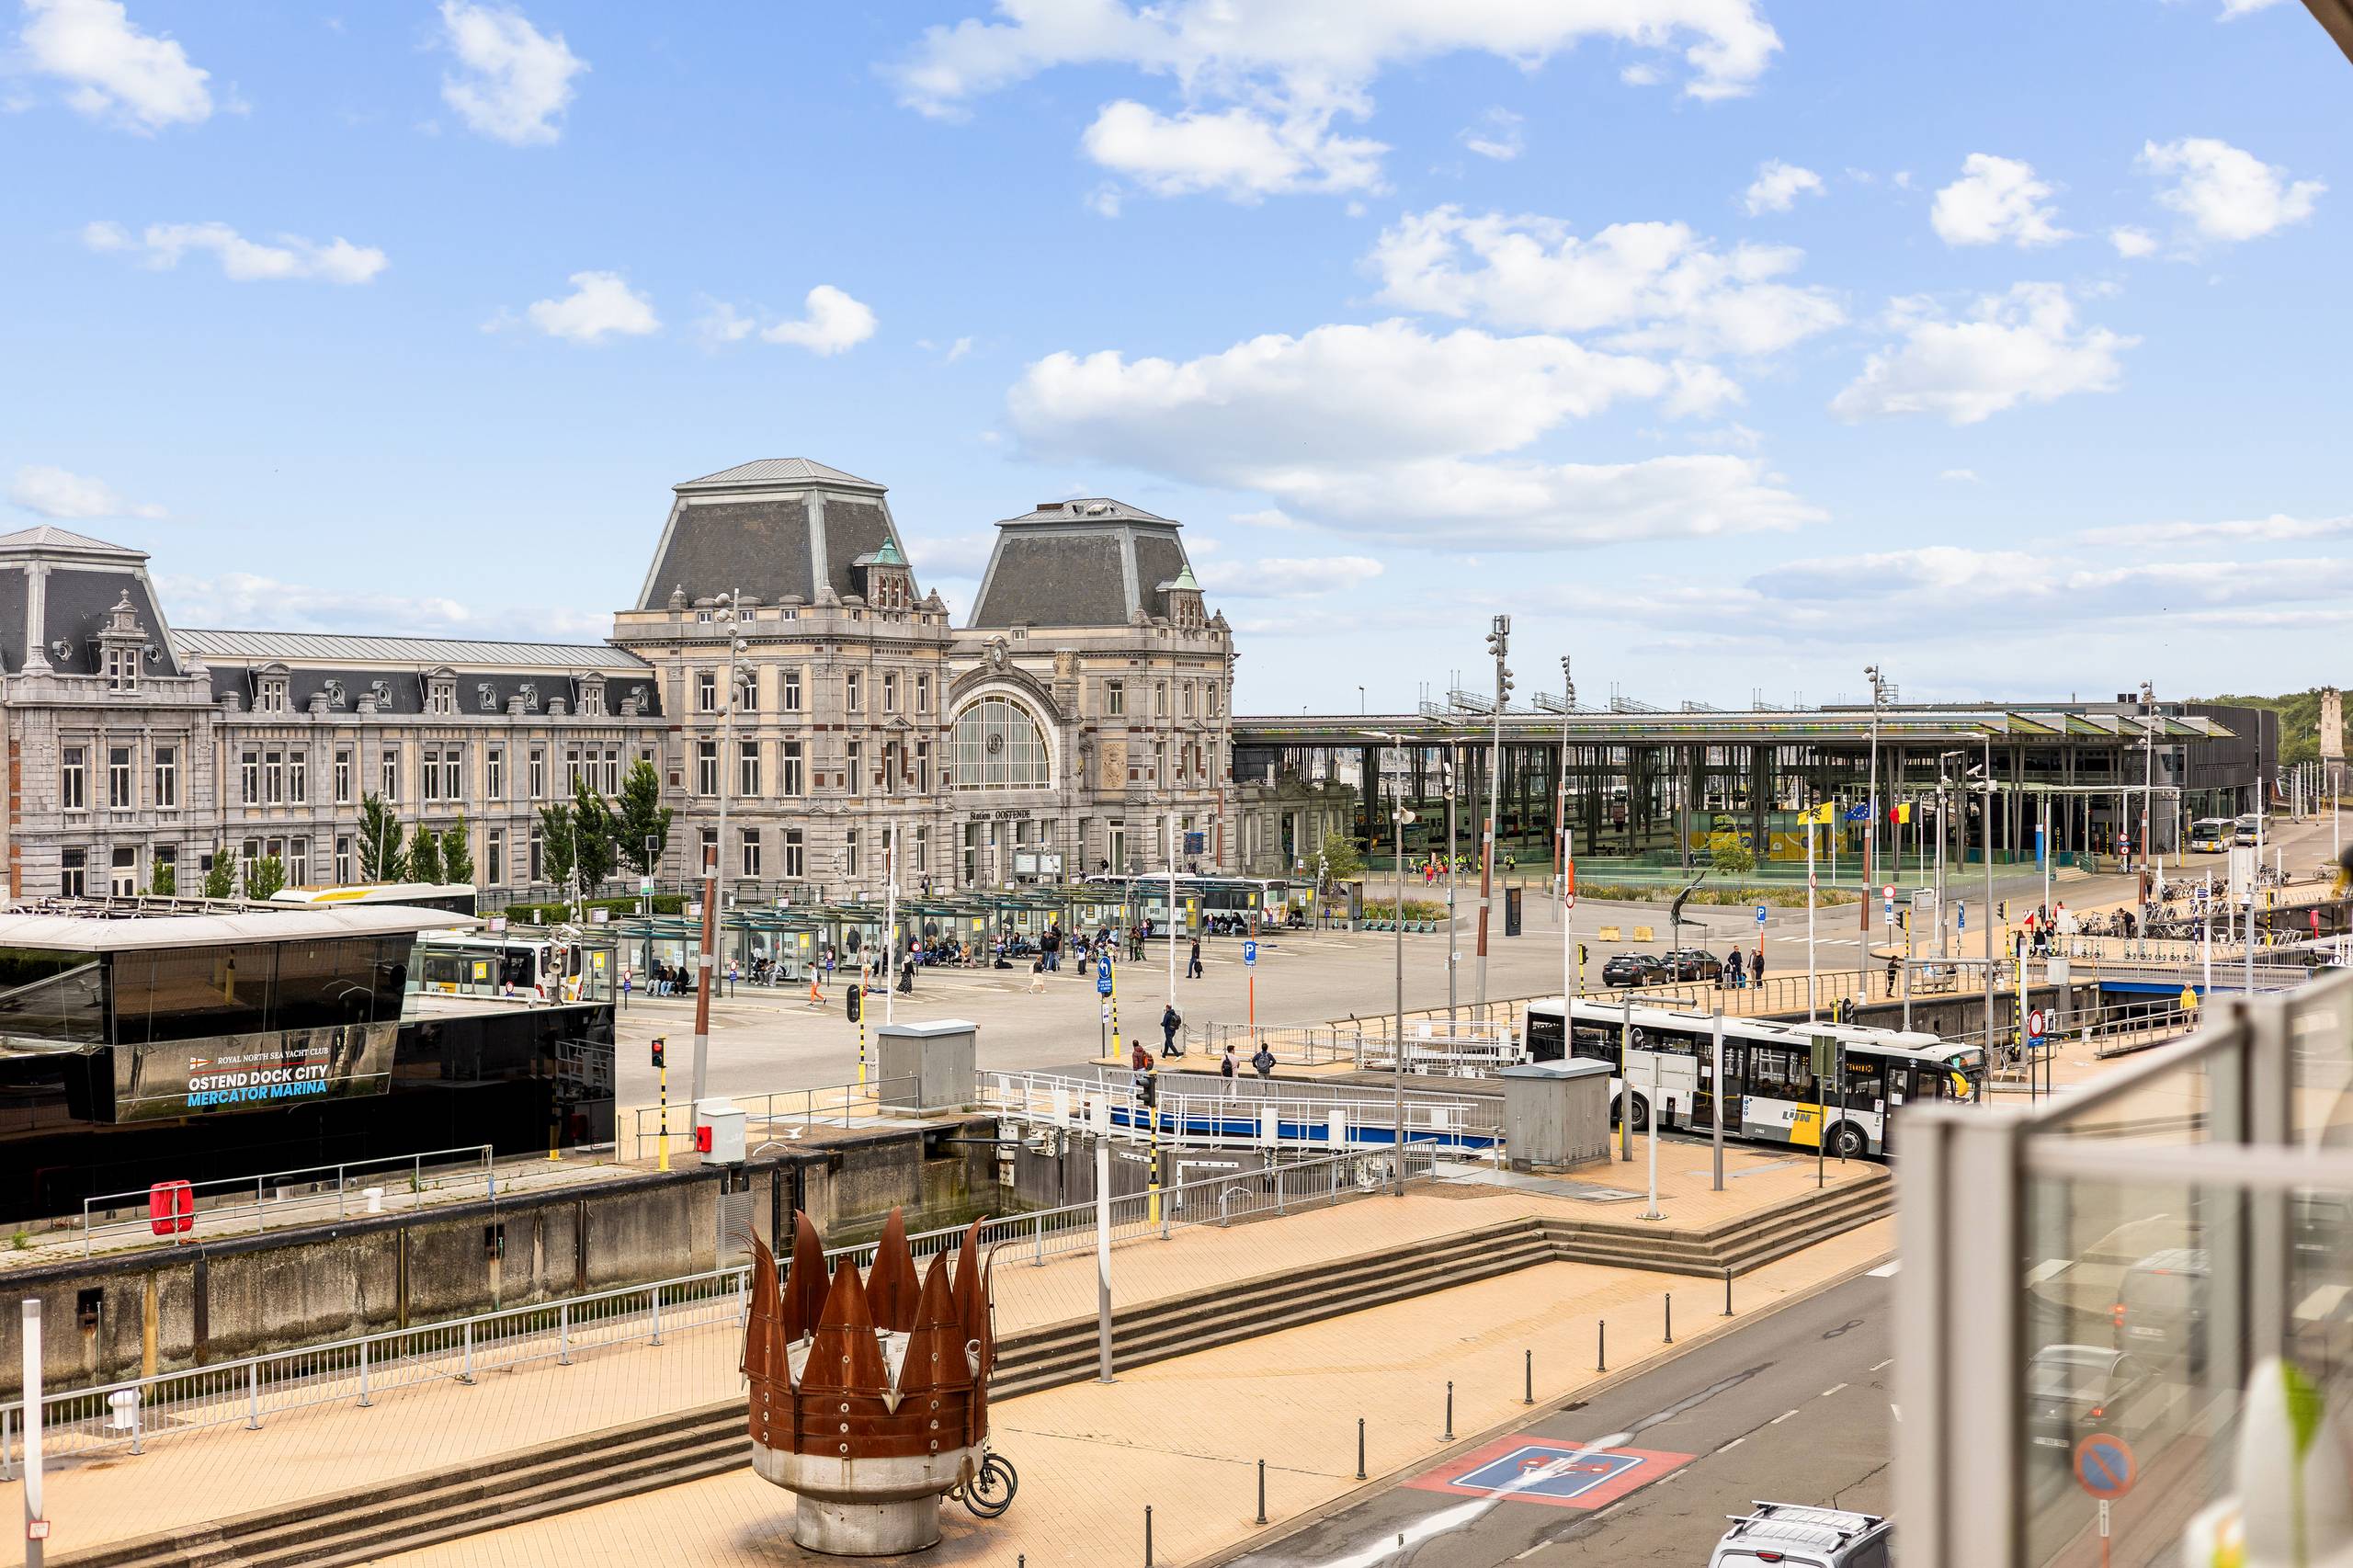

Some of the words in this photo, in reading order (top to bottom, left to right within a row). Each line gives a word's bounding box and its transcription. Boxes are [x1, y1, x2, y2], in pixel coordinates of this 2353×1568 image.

[995, 810, 1030, 820] OOSTENDE
[1757, 908, 1765, 918] P
[1245, 944, 1255, 957] P
[217, 1055, 242, 1065] ROYAL
[243, 1052, 269, 1062] NORTH
[269, 1051, 284, 1060] SEA
[285, 1049, 309, 1058] YACHT
[310, 1047, 329, 1056] CLUB
[188, 1073, 247, 1091] OSTEND
[250, 1068, 292, 1085] DOCK
[295, 1064, 329, 1080] CITY
[188, 1085, 268, 1107] MERCATOR
[270, 1079, 326, 1098] MARINA
